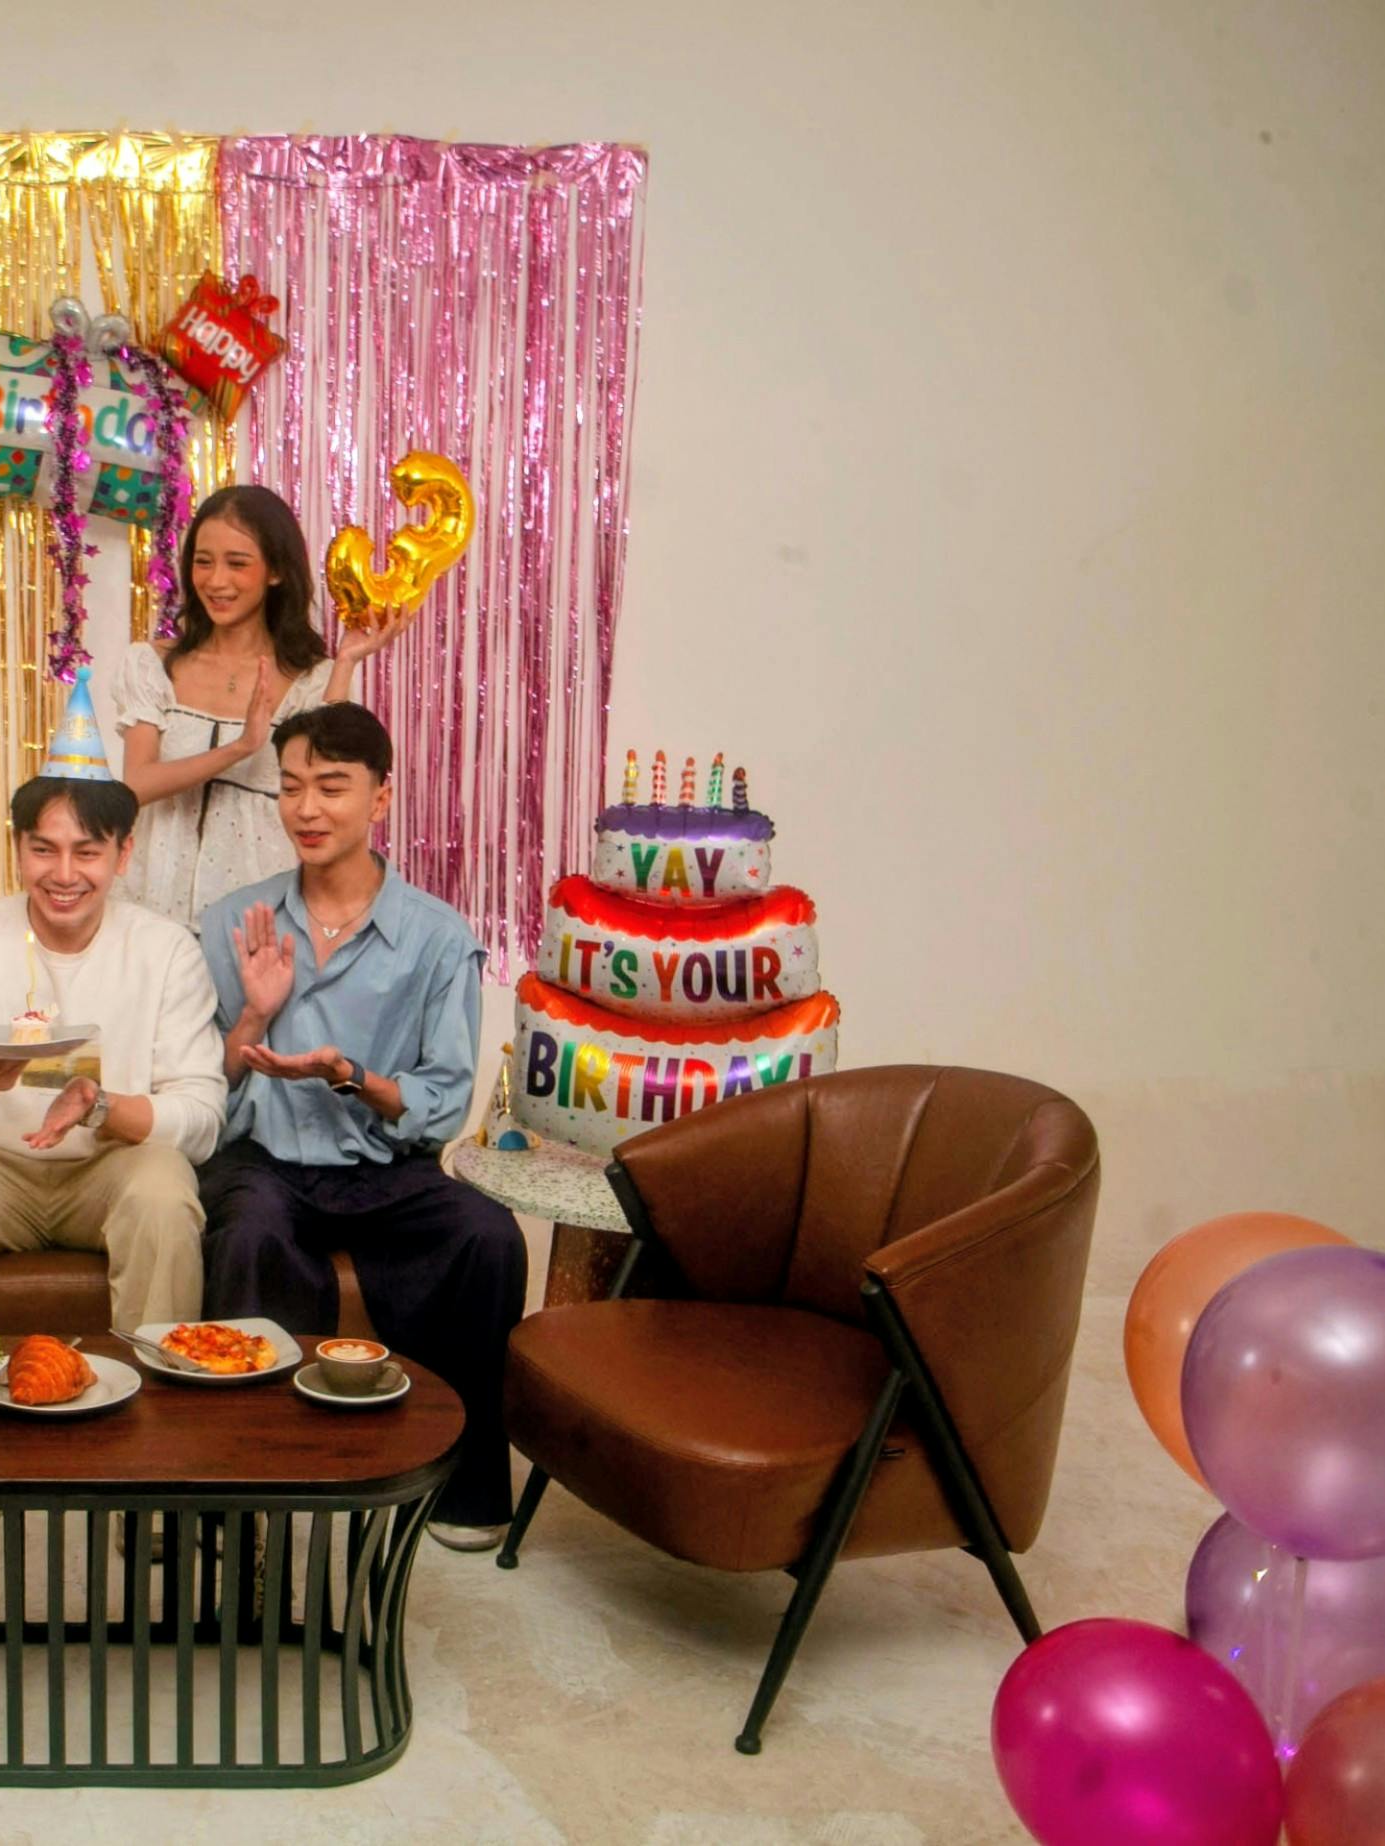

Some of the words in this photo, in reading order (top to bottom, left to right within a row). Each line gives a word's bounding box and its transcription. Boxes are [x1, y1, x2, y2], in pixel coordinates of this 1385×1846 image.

[178, 305, 262, 384] Happy
[327, 448, 476, 630] 3
[630, 843, 725, 898] YAY
[559, 933, 638, 999] IT'S
[653, 945, 782, 1001] YOUR
